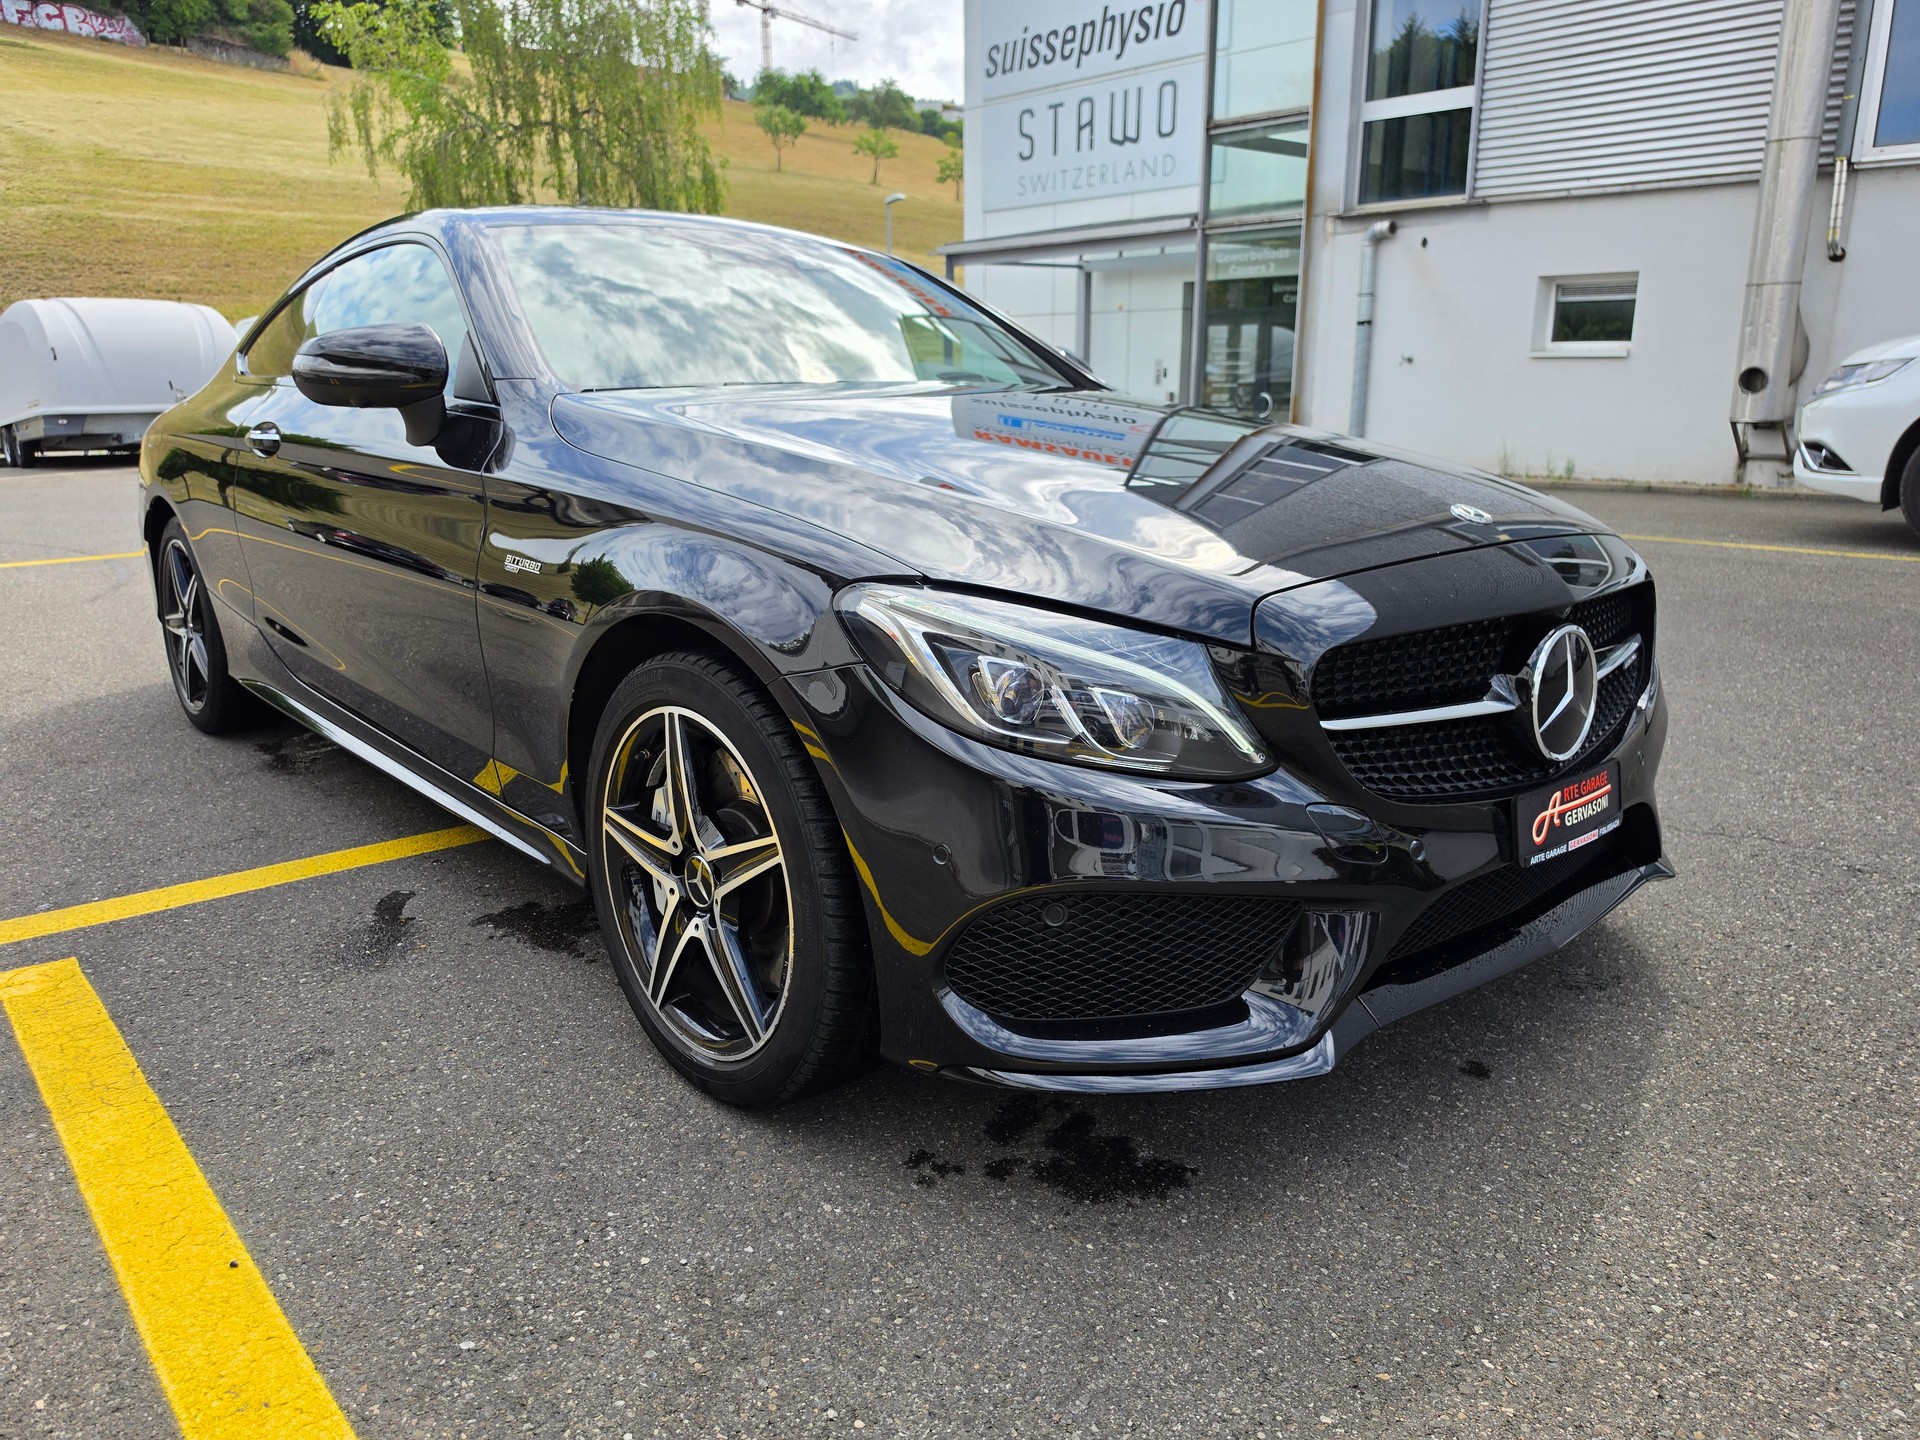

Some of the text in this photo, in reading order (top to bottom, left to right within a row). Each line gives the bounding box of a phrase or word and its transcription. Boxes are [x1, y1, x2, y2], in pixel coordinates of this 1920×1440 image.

[986, 0, 1186, 78] suissephysio
[1018, 80, 1177, 161] STAWO
[1017, 154, 1176, 197] SWITZERLAND
[505, 554, 541, 571] BITURBO
[1580, 771, 1608, 795] GARAGE
[1564, 794, 1609, 827] GERVASONI
[1530, 853, 1546, 865] ARTE
[1545, 844, 1567, 859] GARAGE
[1569, 832, 1598, 849] GERVASONI
